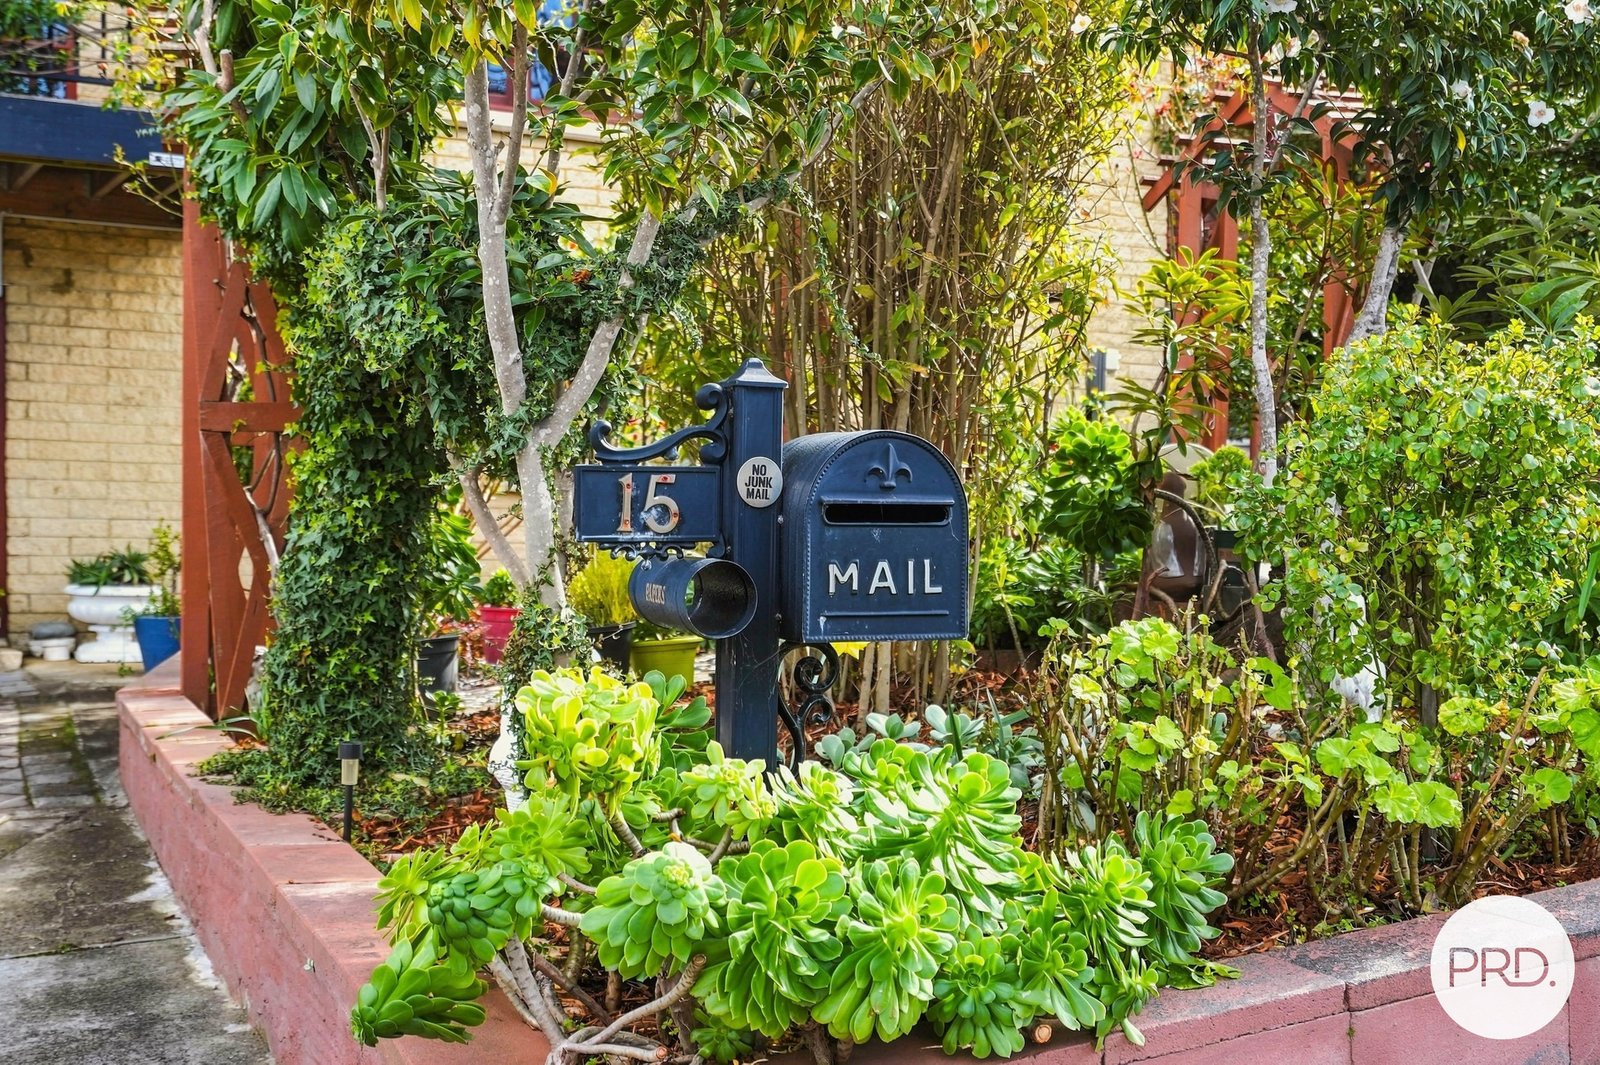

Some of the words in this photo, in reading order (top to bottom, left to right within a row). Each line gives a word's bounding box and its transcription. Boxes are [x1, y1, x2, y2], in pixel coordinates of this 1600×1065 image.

[752, 464, 767, 476] NO
[744, 476, 773, 488] JUNK
[746, 488, 770, 500] MAIL
[616, 473, 679, 533] 15
[828, 559, 943, 596] MAIL
